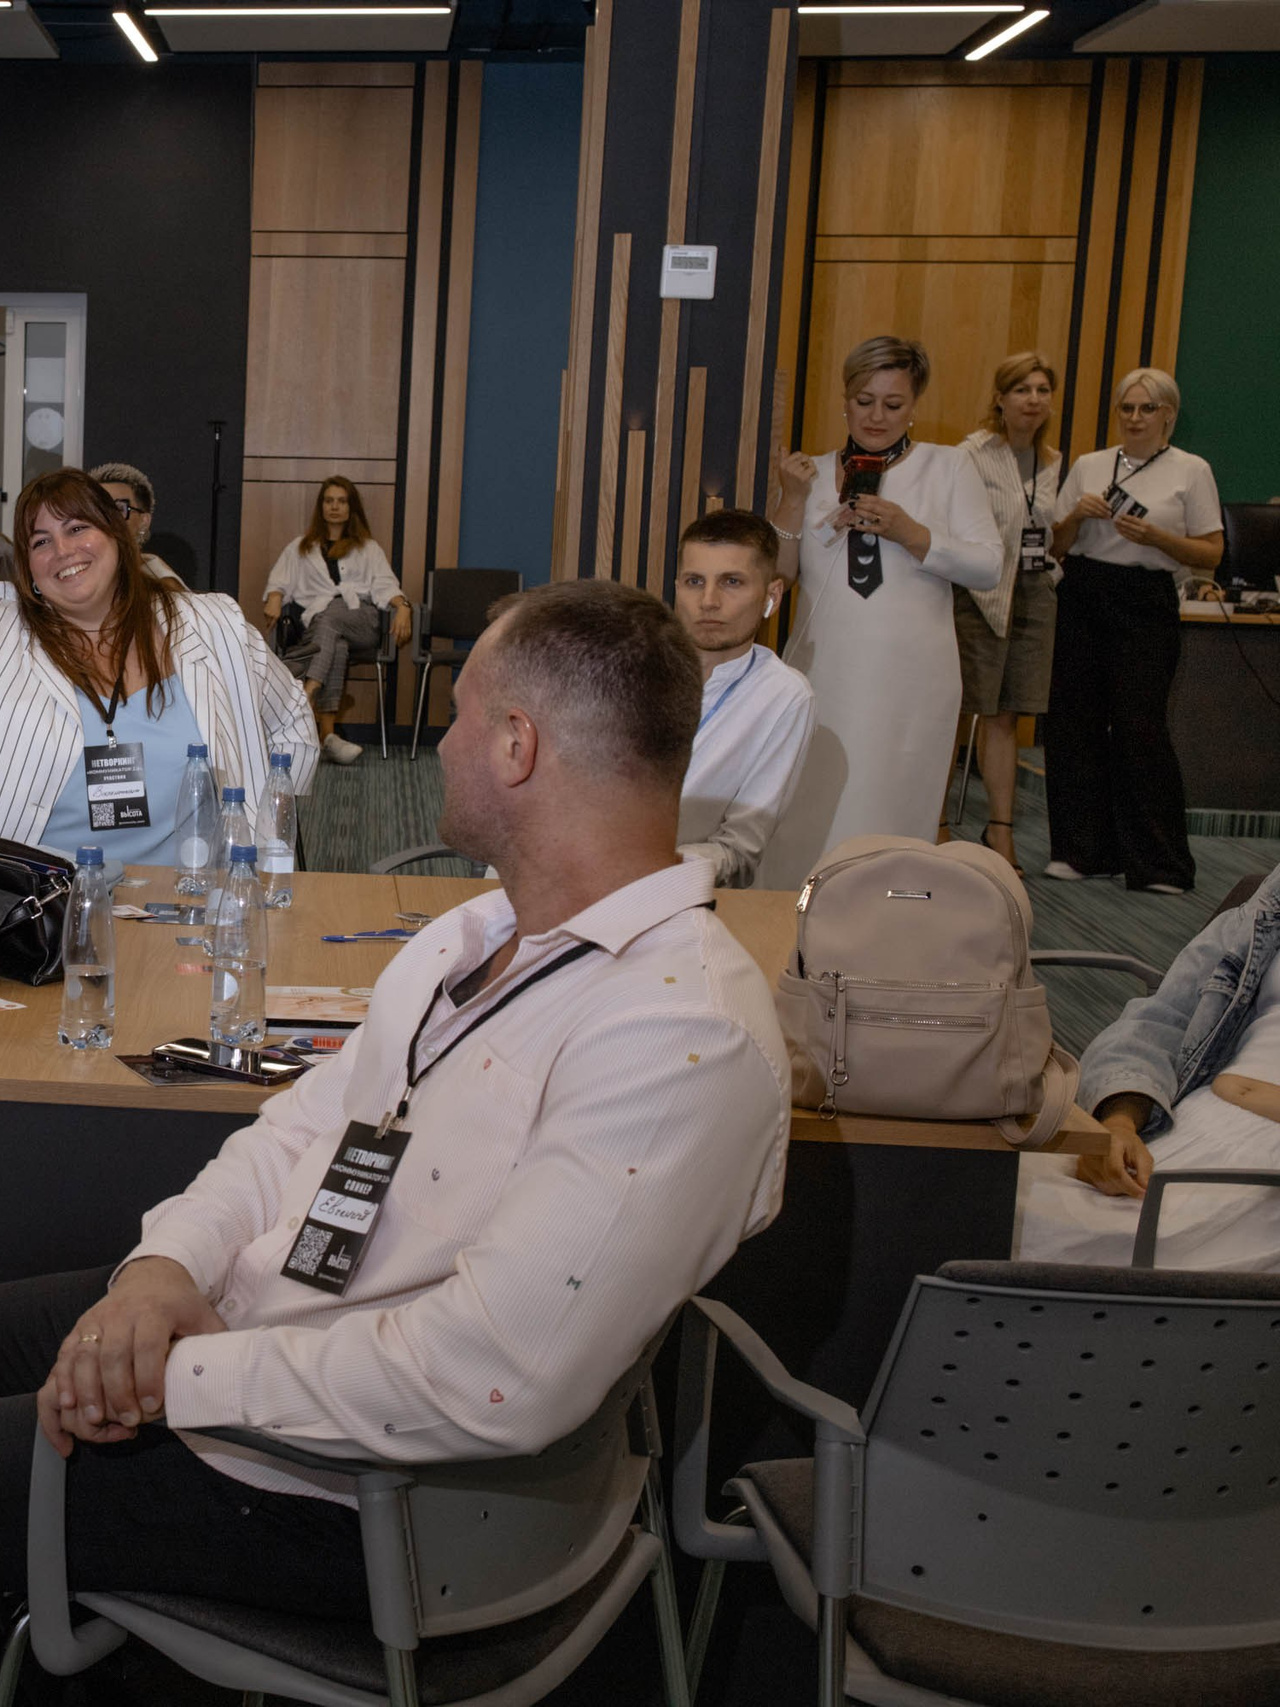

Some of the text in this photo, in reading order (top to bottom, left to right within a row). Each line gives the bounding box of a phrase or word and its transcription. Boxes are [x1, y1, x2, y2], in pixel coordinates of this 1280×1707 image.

[91, 757, 135, 768] НЕТВОРКИНГ
[120, 805, 143, 818] ВЫСОТА
[343, 1179, 374, 1196] СПИКЕР
